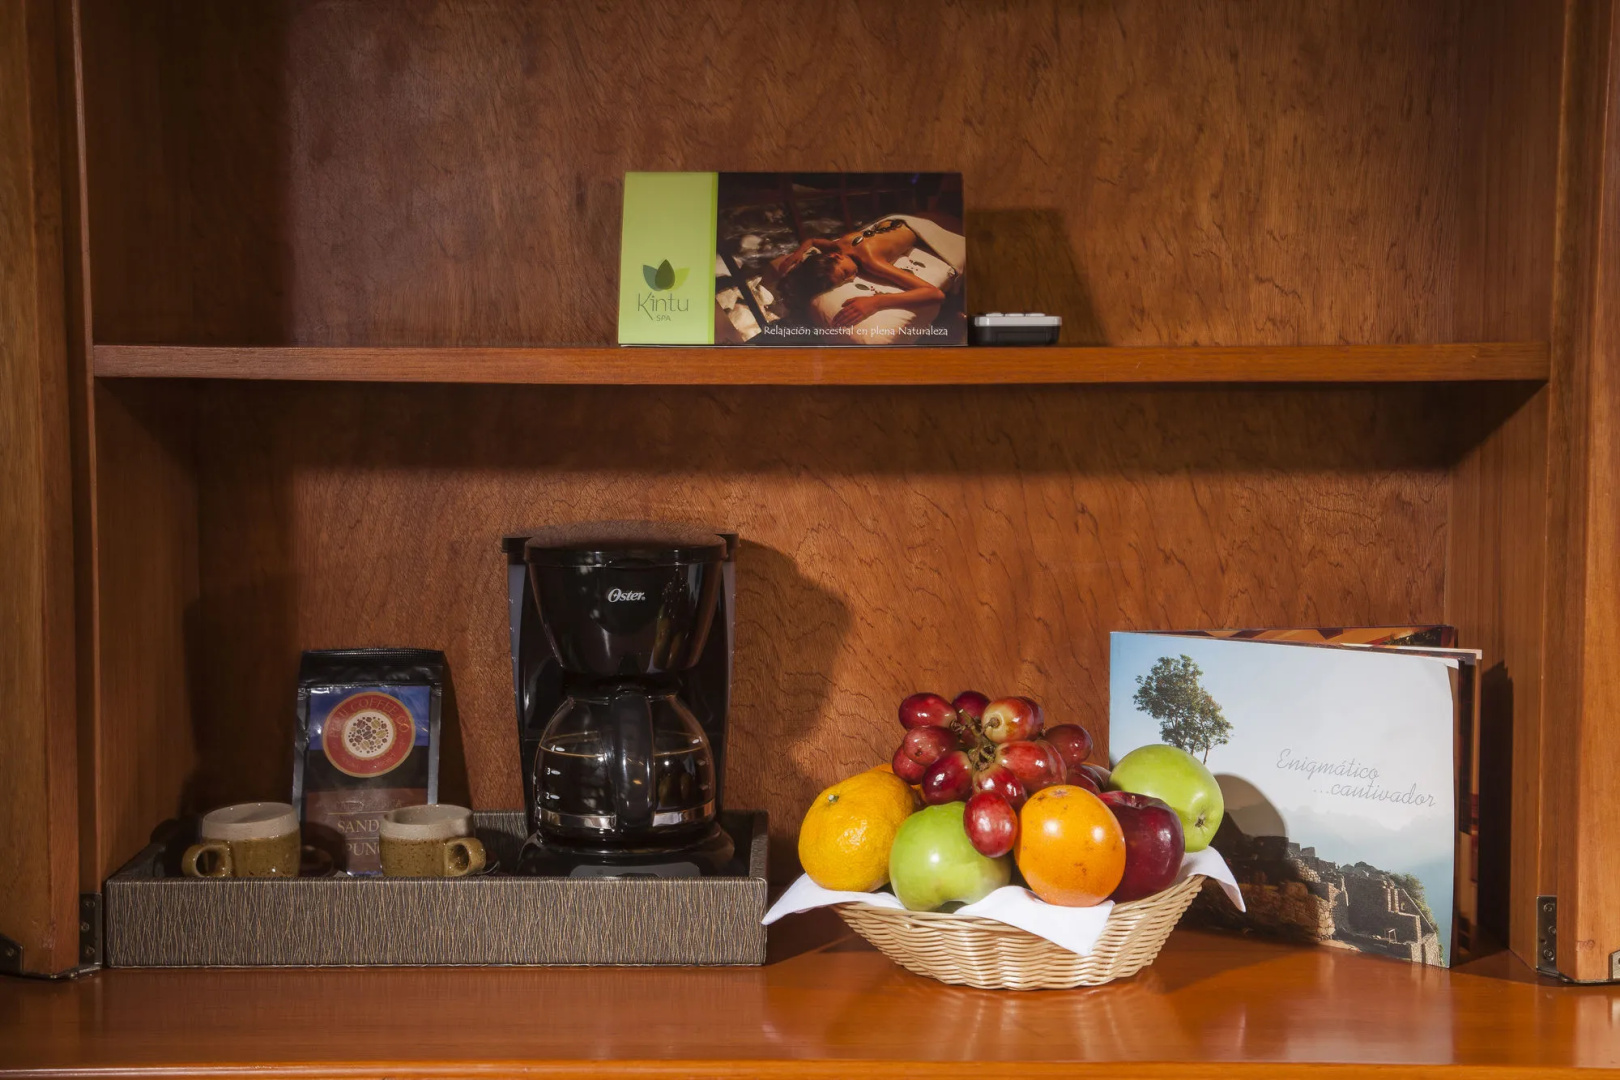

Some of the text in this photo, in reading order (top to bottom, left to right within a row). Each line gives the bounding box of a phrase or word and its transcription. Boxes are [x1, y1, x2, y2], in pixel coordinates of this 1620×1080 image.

[637, 291, 690, 321] Kintu
[656, 314, 672, 322] SPA
[763, 325, 948, 337] Relajación ancestral en plena Naturaleza
[607, 588, 645, 603] Oster
[351, 696, 400, 716] COFFEE
[1276, 748, 1380, 780] Enigmático
